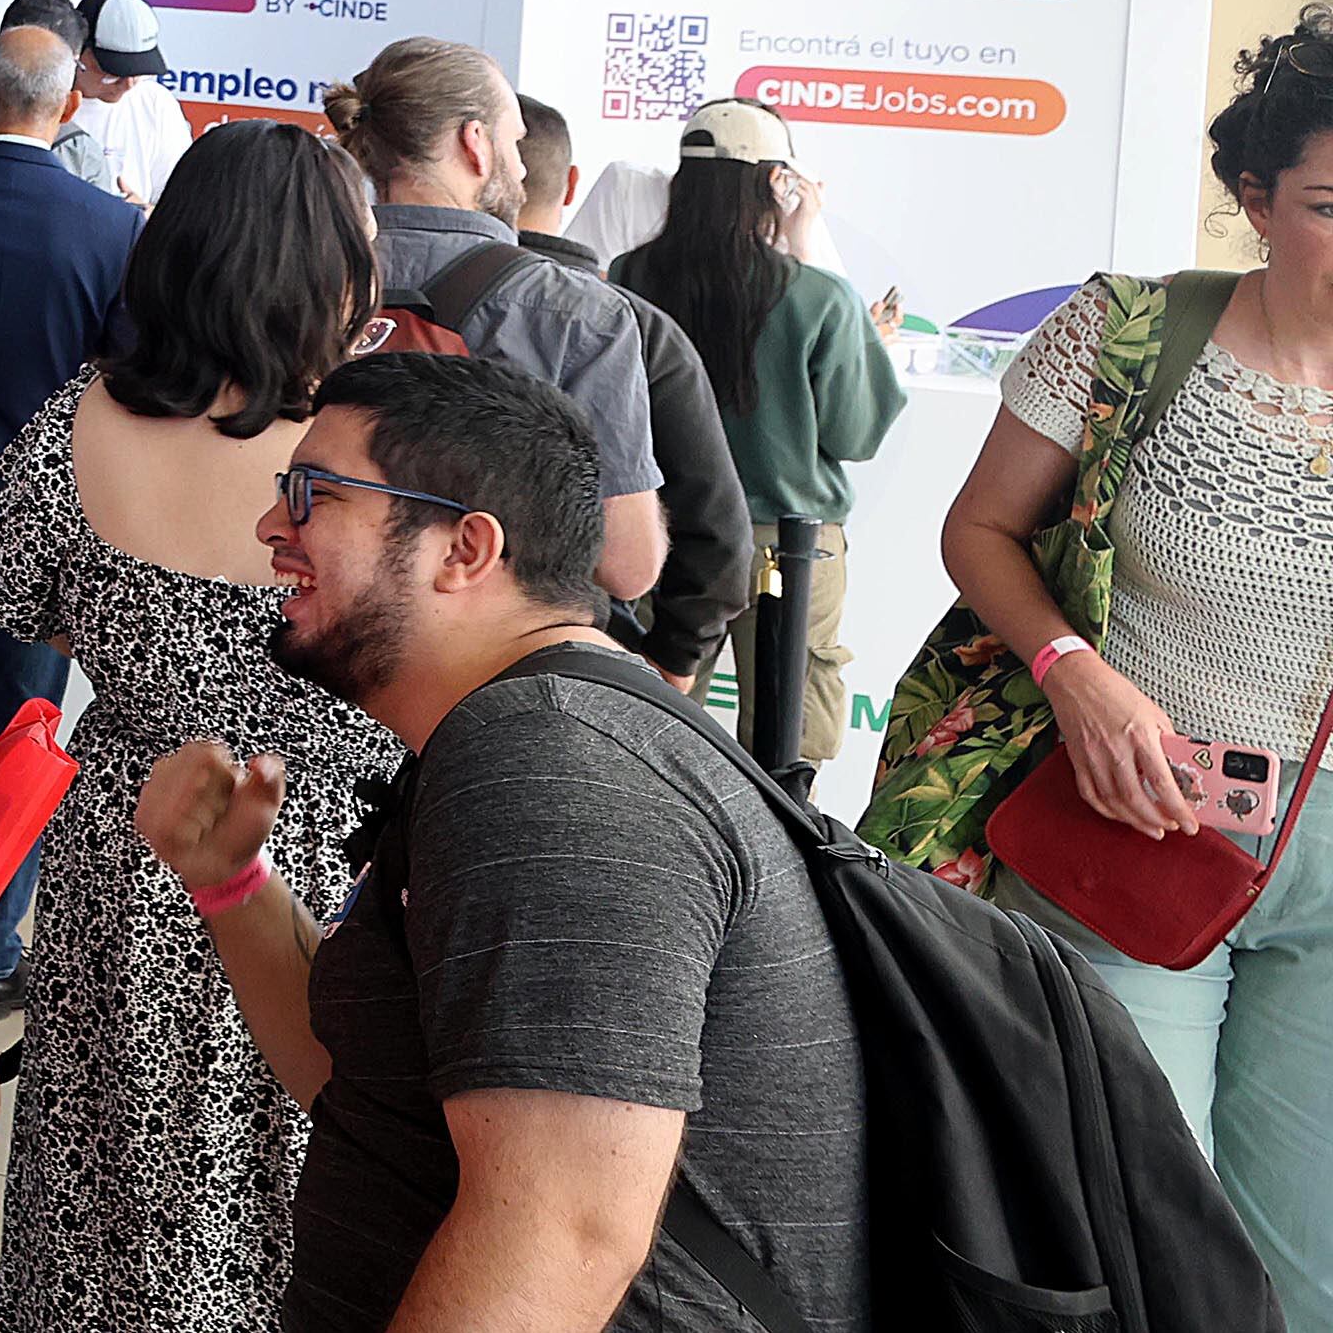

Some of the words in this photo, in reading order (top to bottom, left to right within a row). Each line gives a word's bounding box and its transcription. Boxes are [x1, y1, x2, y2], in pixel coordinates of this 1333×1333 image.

[739, 30, 860, 58] Encontrá
[870, 37, 893, 59] el
[903, 41, 969, 66] tuyo
[980, 45, 1016, 65] en
[156, 67, 298, 102] empleo
[756, 79, 1038, 121] CINDEJobs.com
